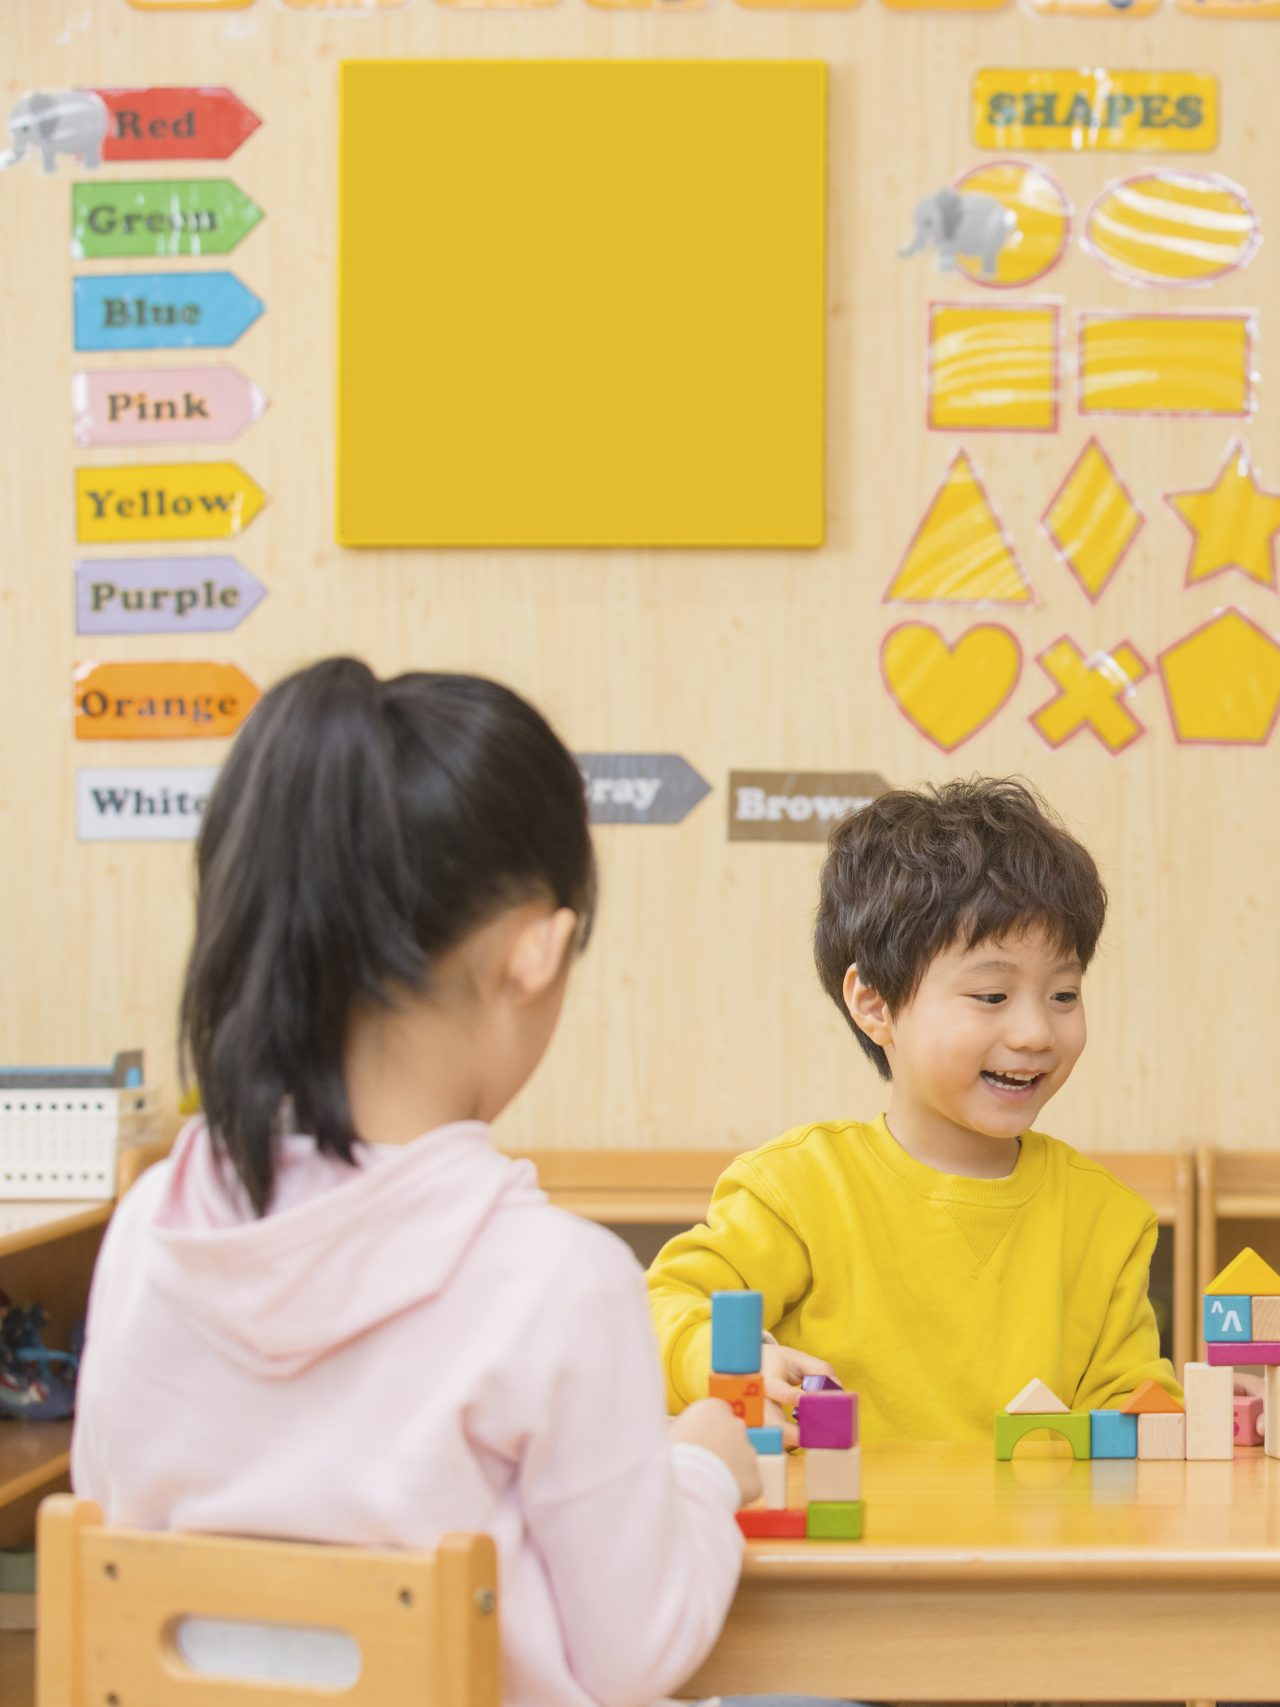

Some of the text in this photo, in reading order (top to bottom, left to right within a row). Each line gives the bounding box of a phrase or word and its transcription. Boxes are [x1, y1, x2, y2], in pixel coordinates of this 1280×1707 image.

[115, 109, 197, 140] Red
[986, 90, 1205, 130] SHAPES
[87, 204, 218, 235] Green
[102, 298, 201, 328] Blue
[107, 392, 209, 422] Pink
[87, 488, 237, 520] Yellow
[89, 578, 241, 617] Purple
[80, 689, 238, 723] Orange
[582, 771, 662, 811] ray
[735, 787, 873, 822] Brow
